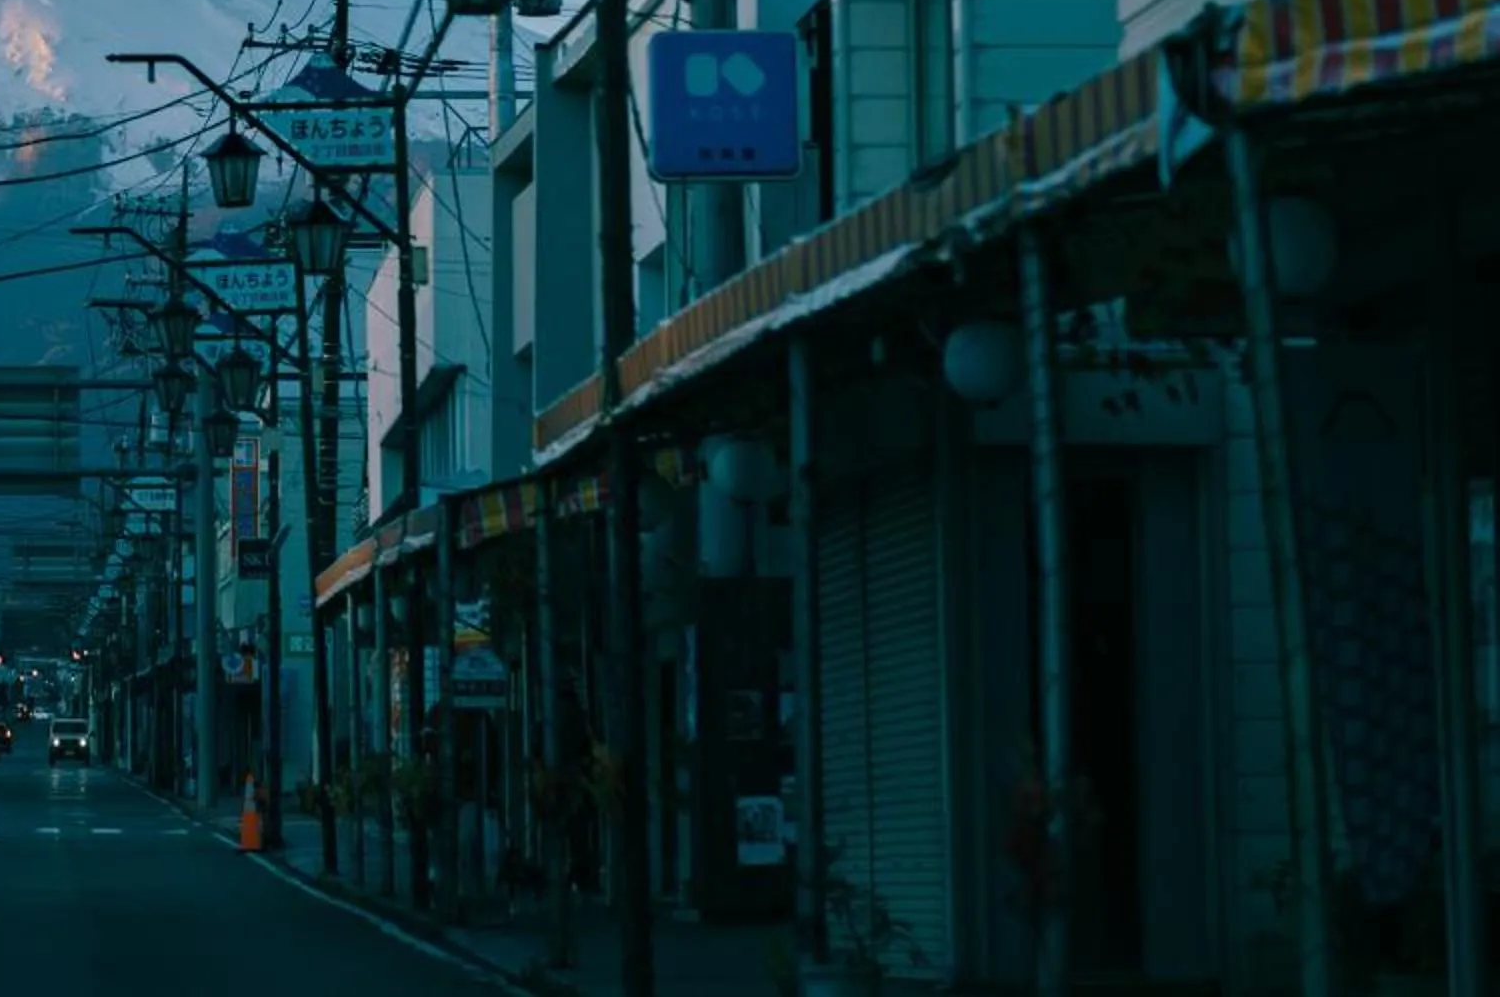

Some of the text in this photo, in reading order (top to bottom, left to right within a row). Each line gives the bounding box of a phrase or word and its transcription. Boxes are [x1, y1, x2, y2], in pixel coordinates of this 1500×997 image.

[290, 115, 386, 140] ほんちょう
